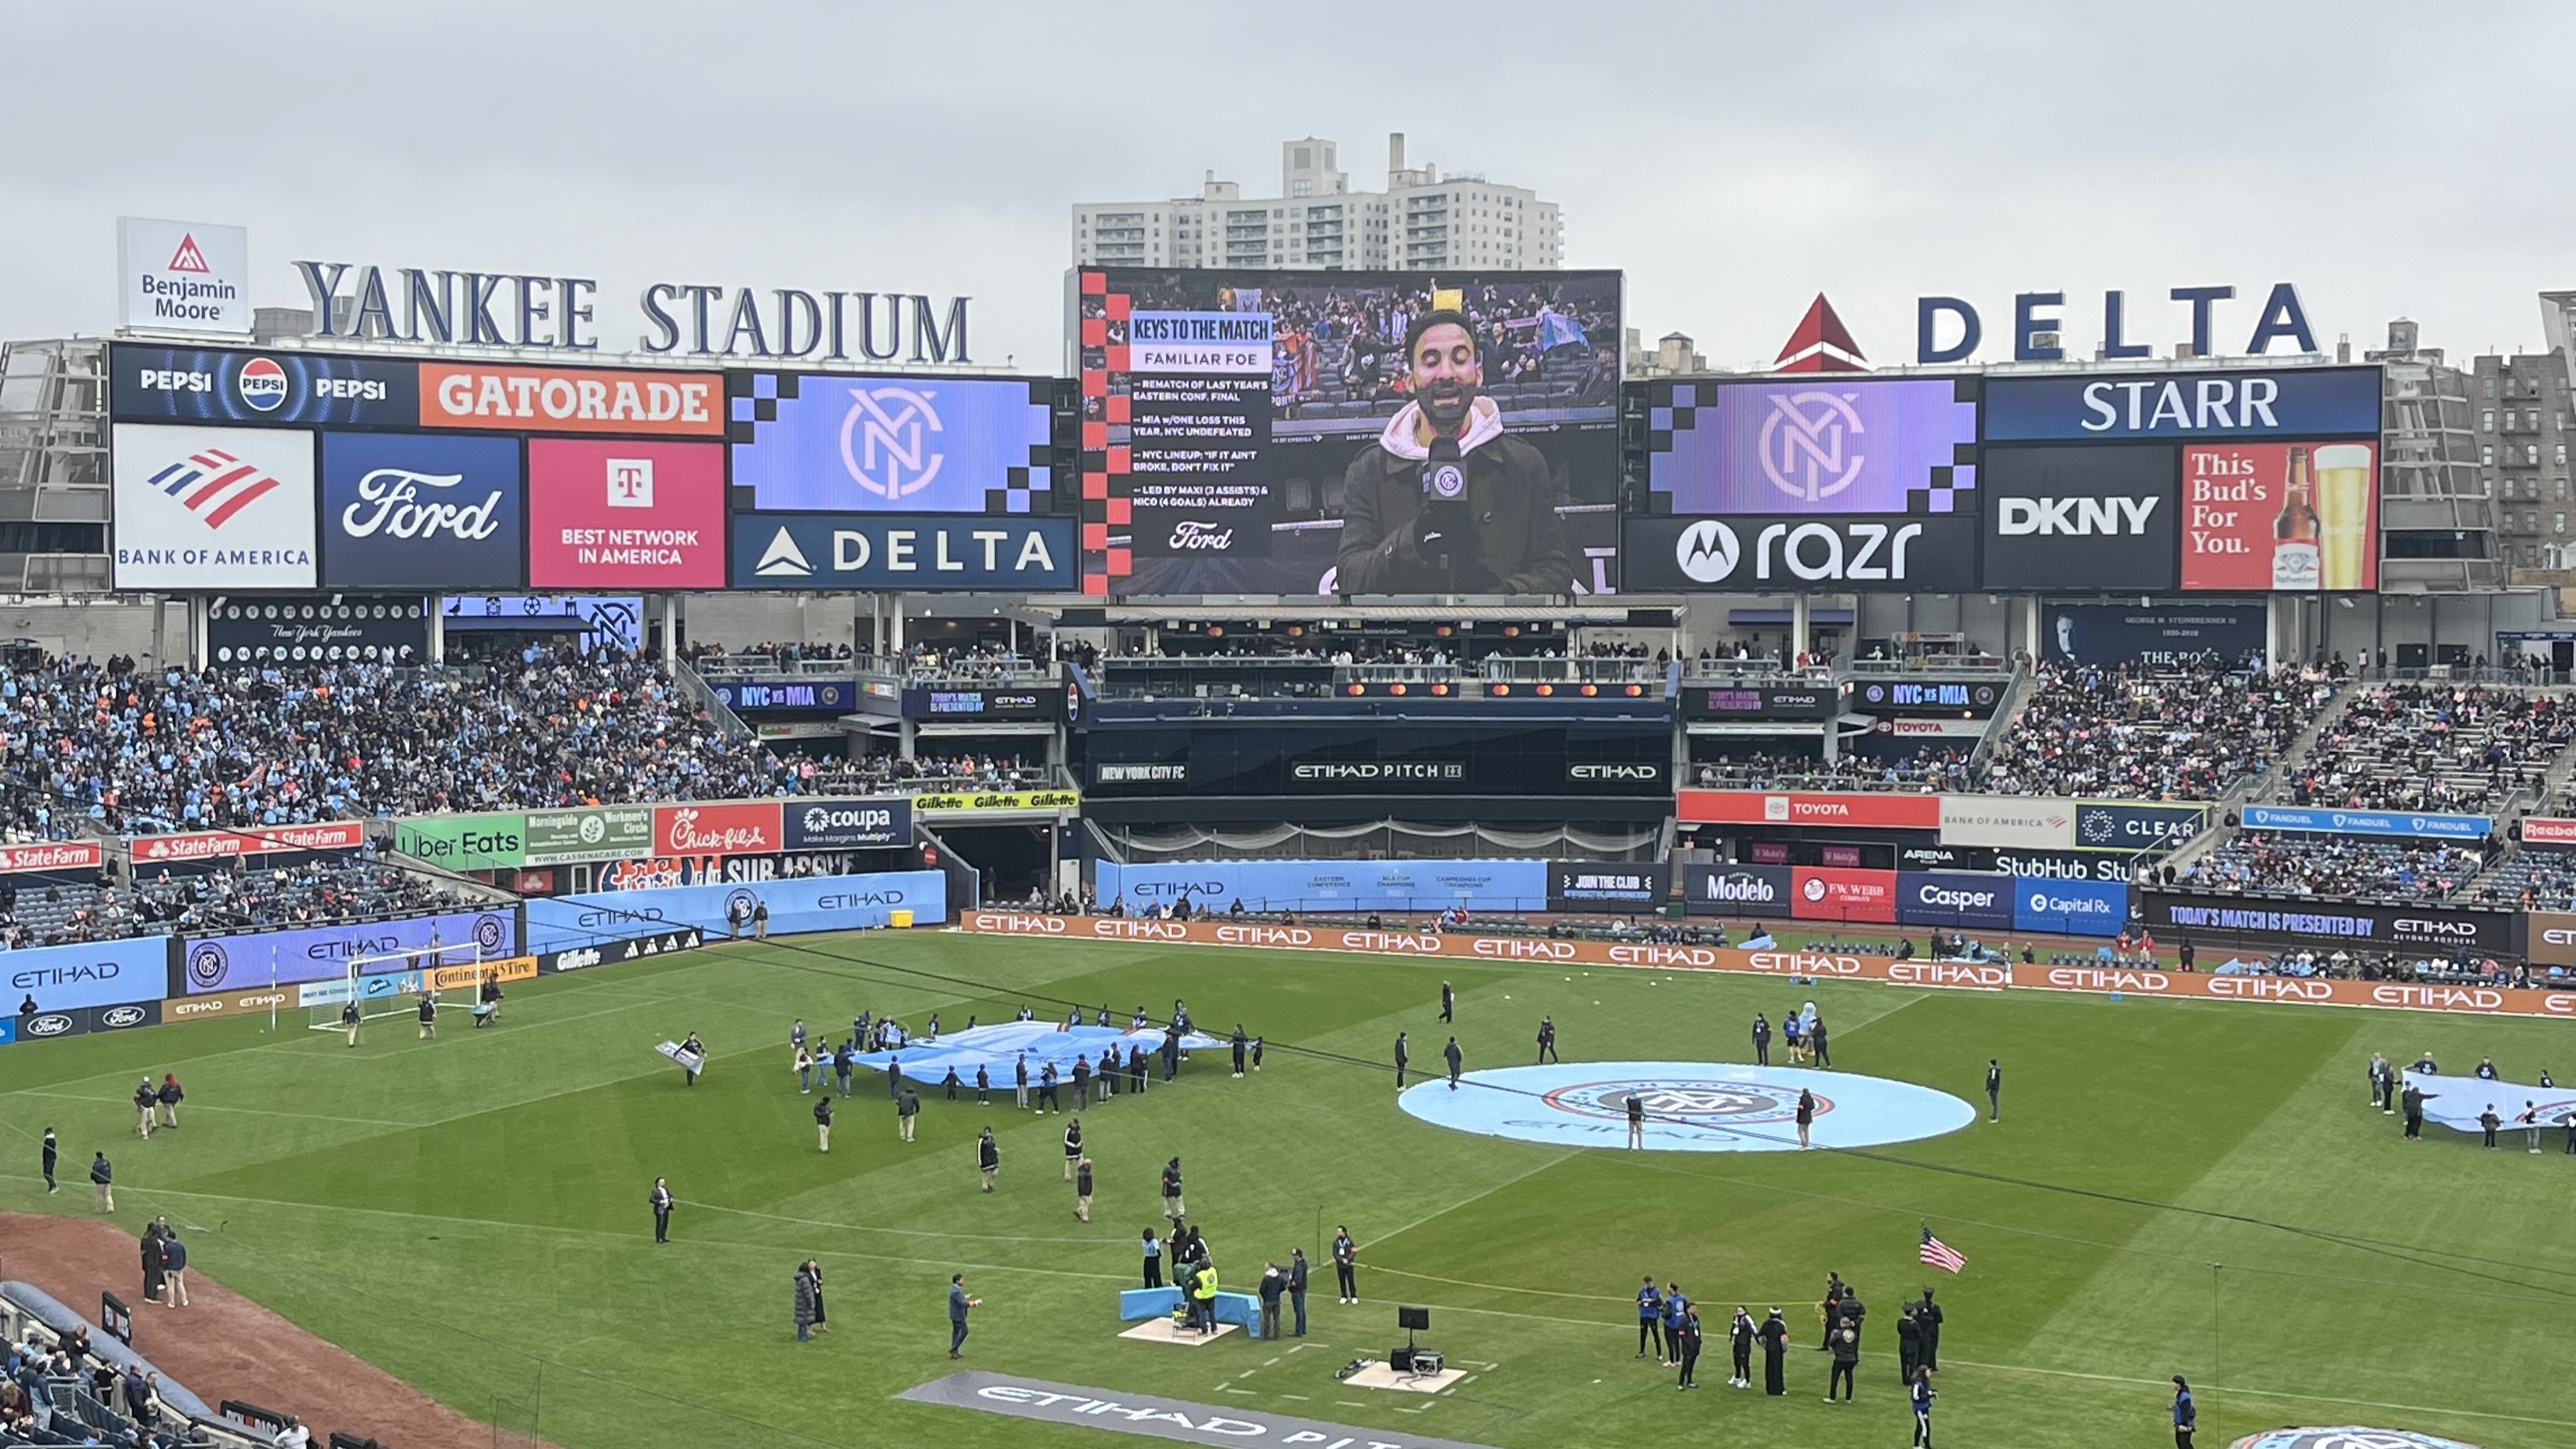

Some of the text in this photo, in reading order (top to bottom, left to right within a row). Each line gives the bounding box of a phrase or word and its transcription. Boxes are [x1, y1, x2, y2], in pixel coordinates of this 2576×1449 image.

[142, 274, 236, 300] Benjamin
[155, 298, 221, 321] Moore
[290, 261, 973, 363] YANKEE STADIUM
[1135, 319, 1268, 340] KEYS TO THE MATCH
[1918, 282, 2320, 364] DELTA
[1145, 354, 1256, 365] FAMILIAR FOE
[141, 369, 211, 393] PEPSI
[243, 376, 285, 393] PEPSI
[316, 378, 386, 400] PEPSI
[1142, 381, 1268, 389] REMATCH OF LAST YEAR'S
[439, 374, 709, 423] GATORADE
[1134, 392, 1240, 401] EASTERN CONF. FINAL
[2080, 378, 2279, 431] STARR
[1164, 428, 1184, 436] NYC
[1186, 428, 1251, 436] UNDEFEATED
[2192, 453, 2254, 475] This
[1142, 486, 1162, 495] LED
[1164, 486, 1176, 495] BY
[1179, 486, 1203, 495] MAXI
[2192, 480, 2267, 501] Bud's
[342, 469, 503, 539] Ford
[1134, 498, 1158, 507] NICO
[1208, 498, 1254, 507] ALREADY
[1998, 497, 2159, 535] DKNY
[2192, 506, 2238, 527] For
[562, 529, 698, 546] BEST NETWORK
[1169, 520, 1233, 549] Ford
[2192, 532, 2250, 554] You.
[118, 549, 309, 565] BANK OF AMERICA
[578, 548, 682, 565] IN AMERICA
[833, 531, 1055, 571] DELTA
[1756, 523, 1923, 580] razr
[271, 624, 362, 642] New York Yankees
[2141, 651, 2172, 664] THE
[741, 687, 816, 706] NYC MIA
[1893, 685, 1969, 704] NYC MIA
[795, 725, 843, 733] TERRACE
[1895, 724, 1943, 733] TOYOTA
[1101, 767, 1185, 780] NEW YORK CITY FC
[1294, 765, 1438, 778] ETIHAD PITCH
[1571, 766, 1657, 779] ETIHAD
[917, 797, 963, 808] Gillette
[975, 796, 1020, 808] Gillette
[1031, 794, 1075, 806] Gillette
[1793, 803, 1849, 816] TOYOTA
[529, 814, 578, 829] Morningside
[831, 809, 890, 831] coupa
[1944, 816, 1974, 825] BANK
[1993, 818, 2043, 827] AMERICA
[2125, 820, 2194, 837] CLEAR
[2269, 814, 2313, 824] FANDUEL
[2347, 818, 2391, 828] FANDUEL
[2427, 821, 2472, 831] FANDUEL
[670, 816, 766, 850] Chick-fil-A
[803, 833, 856, 843] Make Margins
[401, 835, 457, 858] Uber
[463, 831, 520, 854] Eats
[1904, 849, 1954, 860] ARENA
[1996, 857, 2088, 879] StubHub
[1134, 882, 1224, 896] ETIHAD
[1575, 875, 1640, 888] JOIN THE CLUB
[1707, 875, 1774, 901] Modelo
[1850, 884, 1884, 896] WEBB
[818, 891, 904, 910] ETIHAD
[1919, 884, 1995, 911] Casper
[2050, 898, 2110, 914] Capital Rx
[579, 907, 664, 928] ETIHAD
[975, 914, 1066, 933] ETIHAD
[2170, 906, 2374, 936] TODAY'S MATCH IS PRESENTED BY
[2393, 918, 2476, 935] ETIHAD
[1095, 920, 1187, 938] ETIHAD
[1216, 926, 1312, 946] ETIHAD
[308, 935, 400, 958] ETIHAD
[1343, 932, 1441, 952] ETIHAD
[1474, 938, 1576, 958] ETIHAD
[2434, 936, 2476, 945] BORDERS
[556, 947, 601, 971] Gillette
[1609, 946, 1716, 966] ETIHAD
[1750, 952, 1860, 974] ETIHAD
[12, 963, 120, 989] ETIHAD
[507, 962, 530, 975] Tire
[1889, 963, 2005, 985] ETIHAD
[2048, 969, 2169, 991] ETIHAD
[2208, 977, 2333, 999] ETIHAD
[239, 993, 286, 1007] ETIHAD
[2372, 986, 2503, 1009] ETIHAD
[110, 1009, 137, 1023] Ford
[175, 1000, 223, 1015] ETIHAD
[36, 1018, 64, 1032] Ford
[976, 1385, 1268, 1436] ETIHAD
